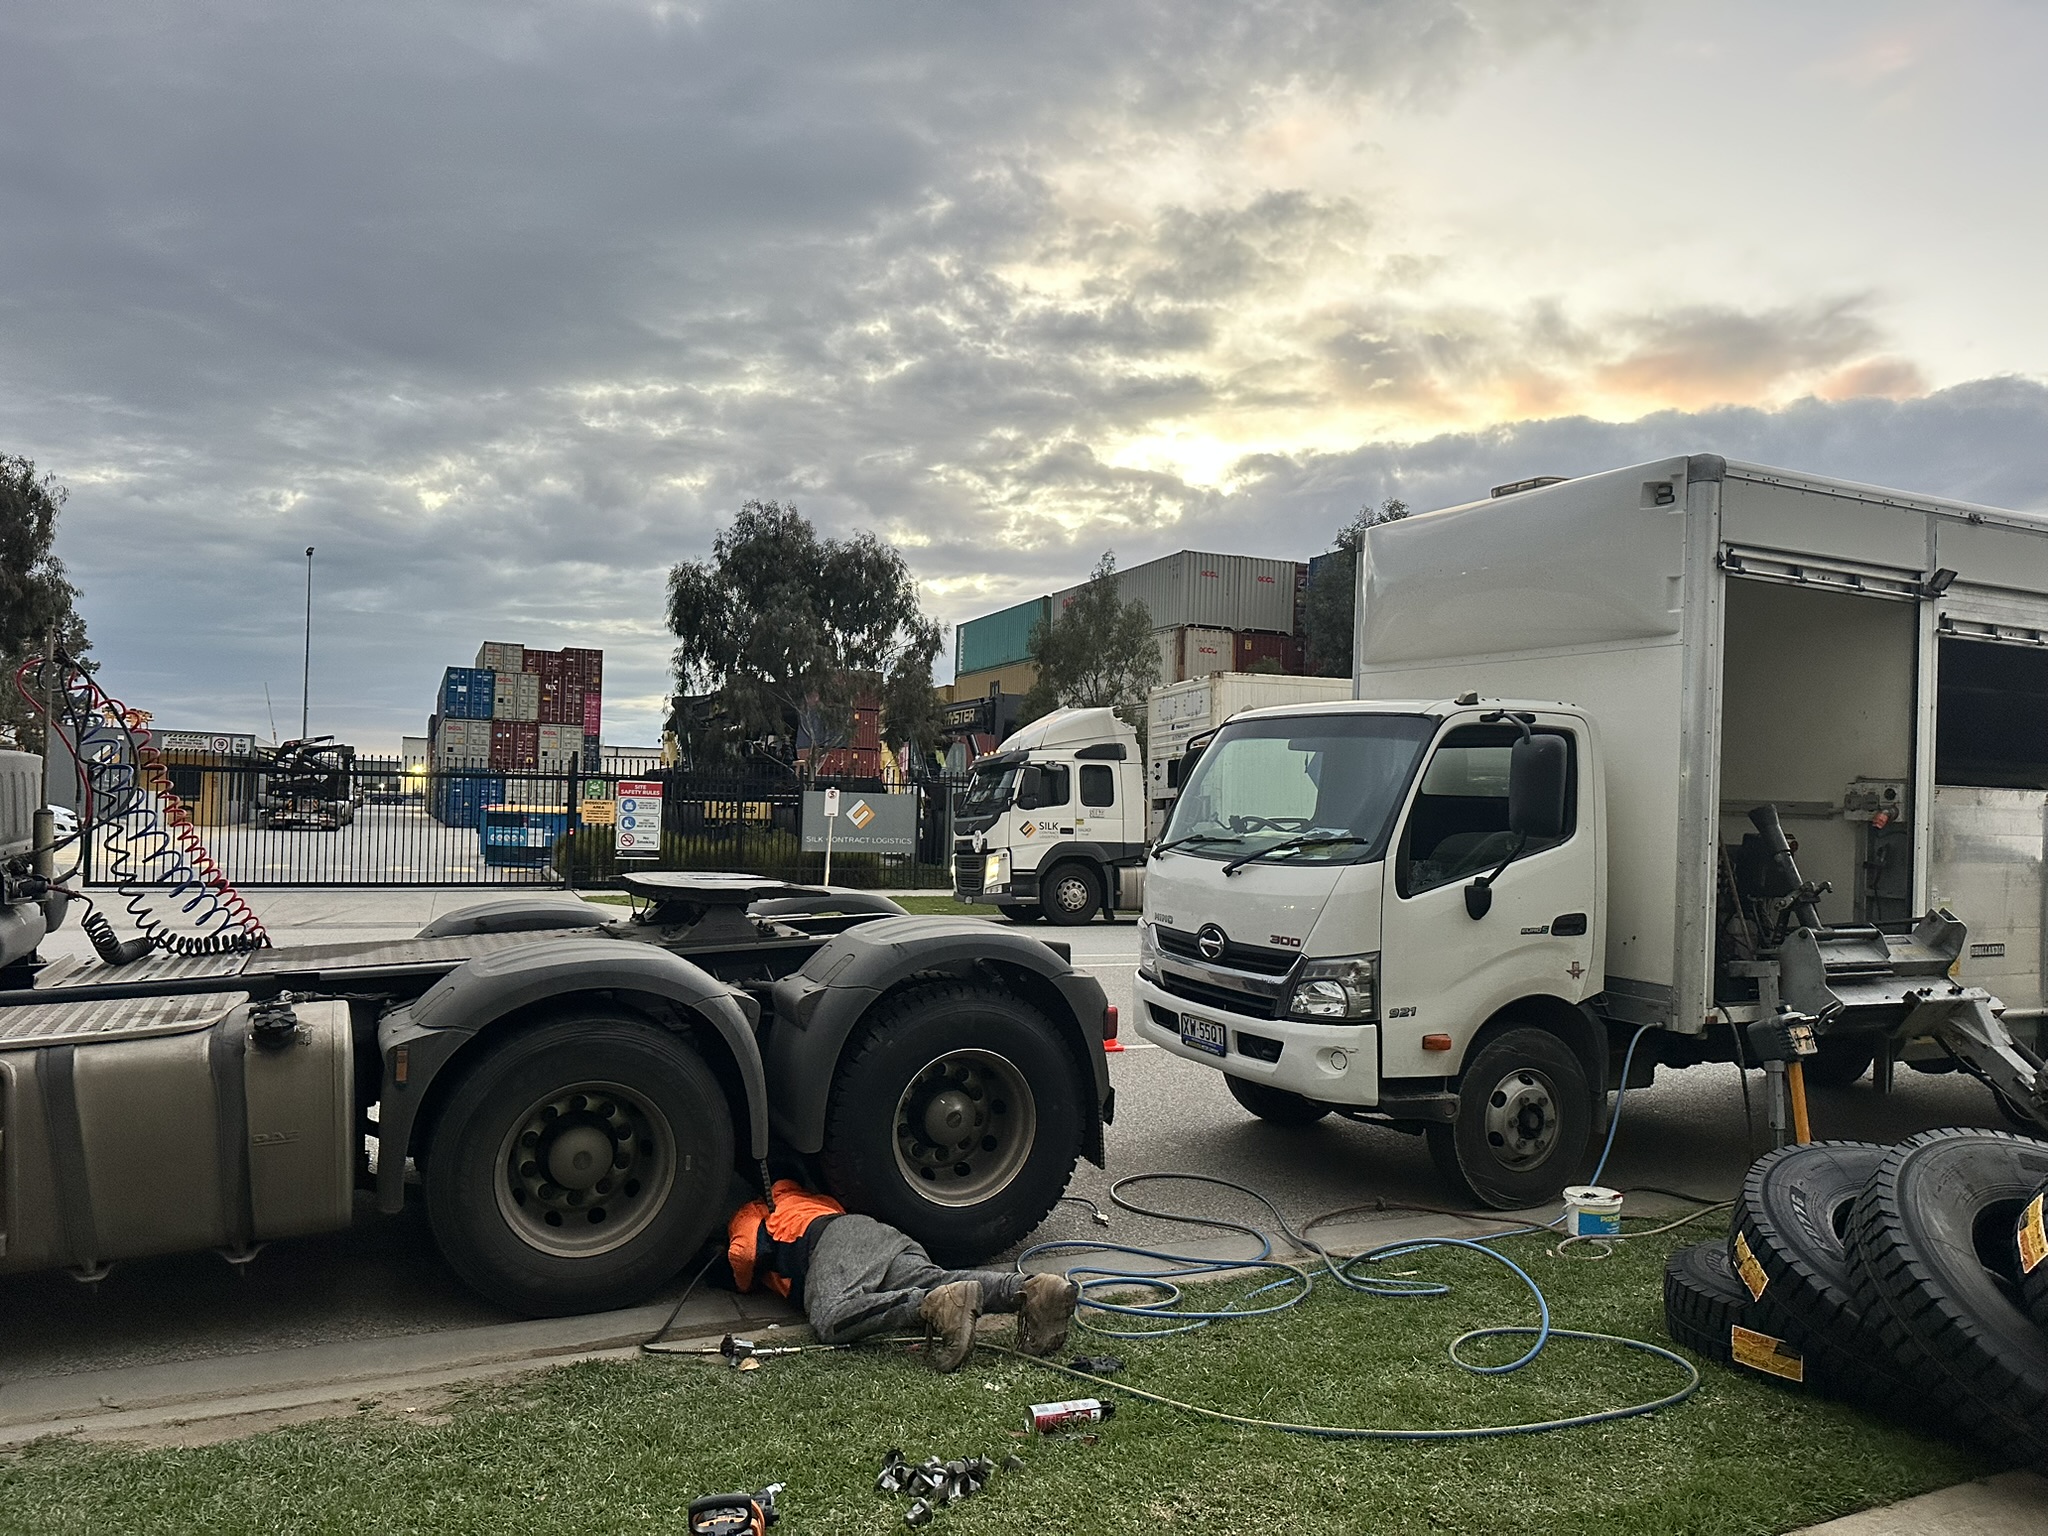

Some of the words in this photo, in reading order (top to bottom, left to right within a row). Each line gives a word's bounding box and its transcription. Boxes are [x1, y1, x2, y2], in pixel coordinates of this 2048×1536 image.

[716, 805, 758, 814] HYSER
[1039, 821, 1059, 831] SILK
[806, 835, 824, 843] SILK
[872, 837, 913, 846] LOGISTICS
[1154, 912, 1174, 925] HINO
[1269, 934, 1301, 948] 300
[1388, 1006, 1417, 1019] 921
